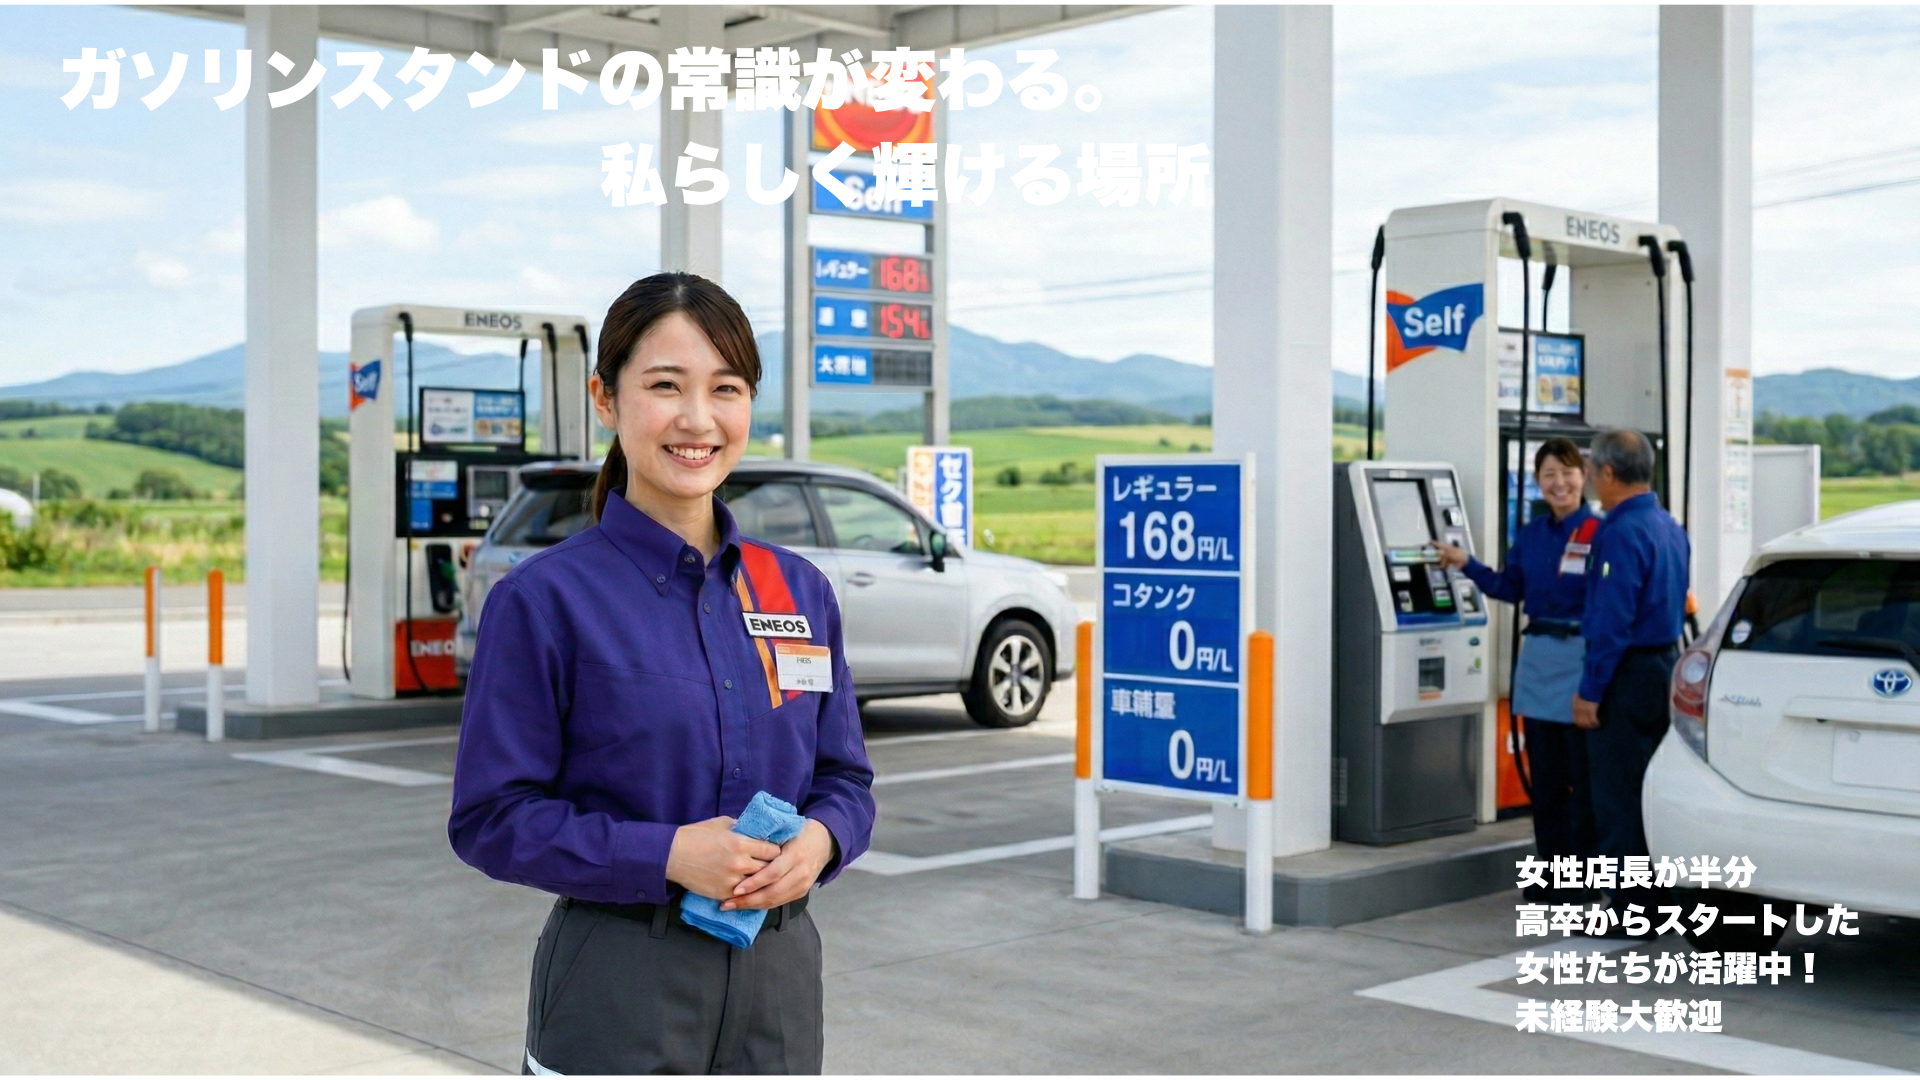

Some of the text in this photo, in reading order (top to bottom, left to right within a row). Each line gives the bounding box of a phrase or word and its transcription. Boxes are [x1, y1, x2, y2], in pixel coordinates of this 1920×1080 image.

[1566, 216, 1621, 244] ENEOS
[464, 312, 522, 329] ENEOS
[1404, 303, 1466, 338] Self
[1113, 475, 1217, 502] レギュラー
[749, 617, 806, 634] ENEOS
